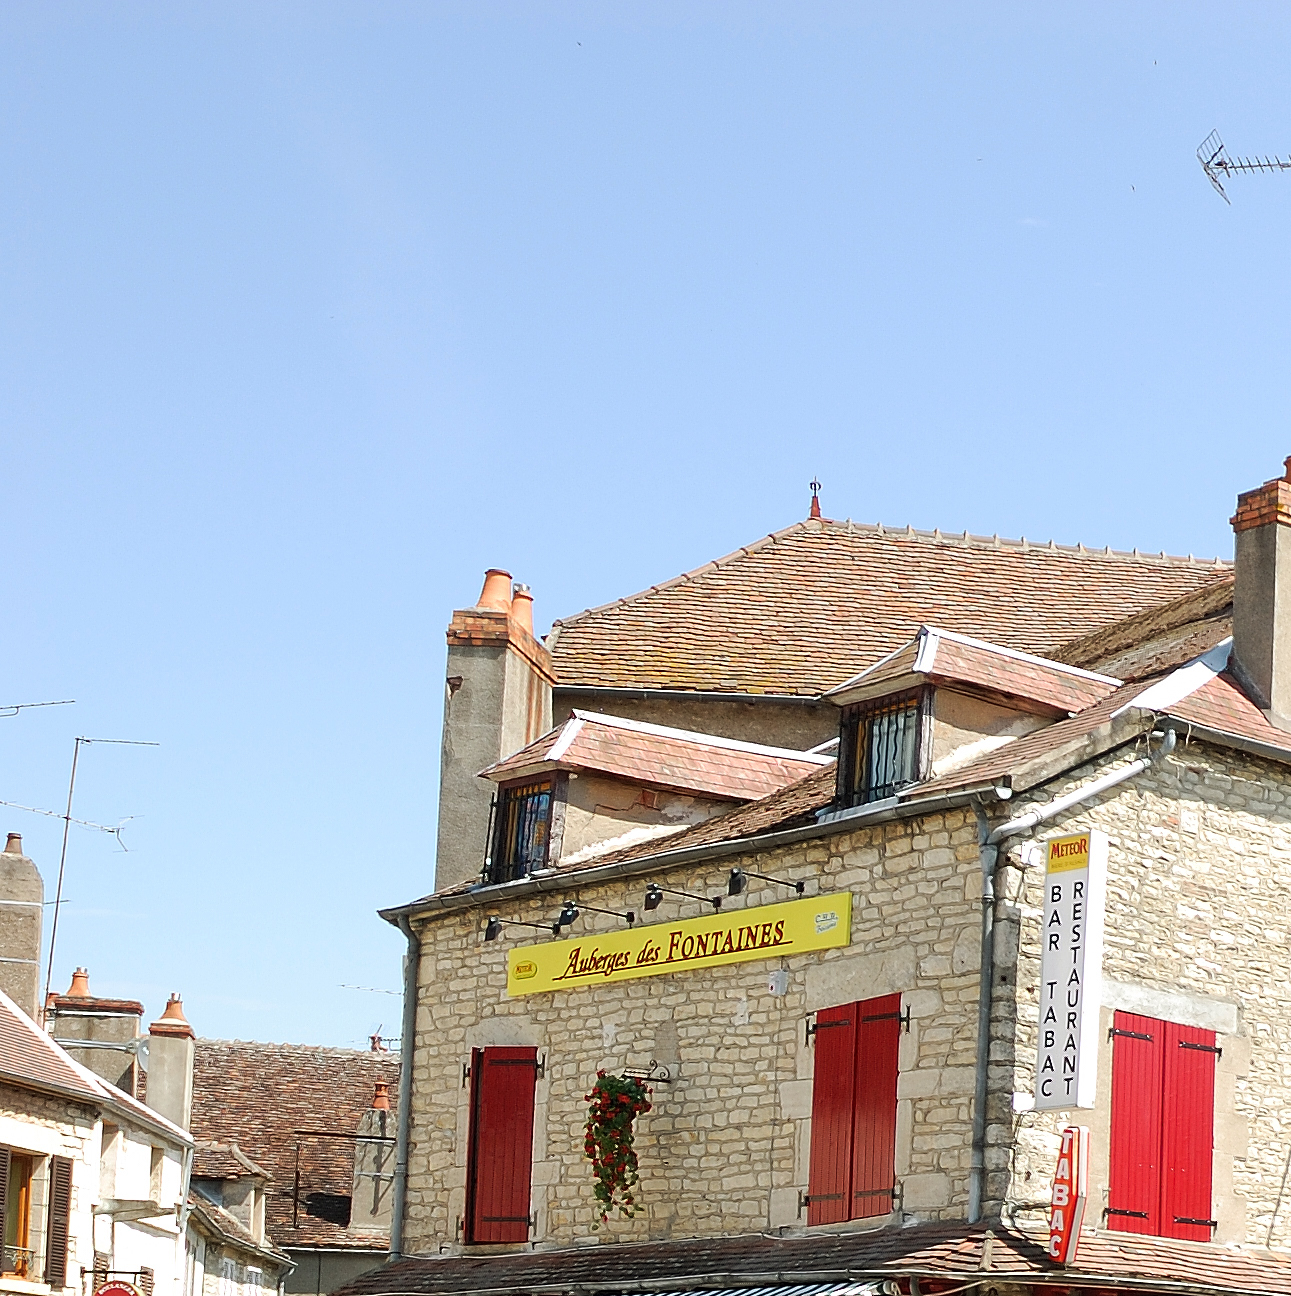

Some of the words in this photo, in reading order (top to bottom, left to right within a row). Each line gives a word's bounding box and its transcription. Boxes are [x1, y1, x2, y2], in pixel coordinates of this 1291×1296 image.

[1051, 838, 1088, 859] METEOR
[563, 946, 630, 977] Auberges
[637, 939, 661, 965] des
[666, 920, 786, 962] FONTAINES
[1047, 885, 1062, 952] BAR
[1063, 881, 1084, 1095] RESTAURANT
[1041, 981, 1058, 1097] TABAC
[1049, 1132, 1073, 1258] TABAC
